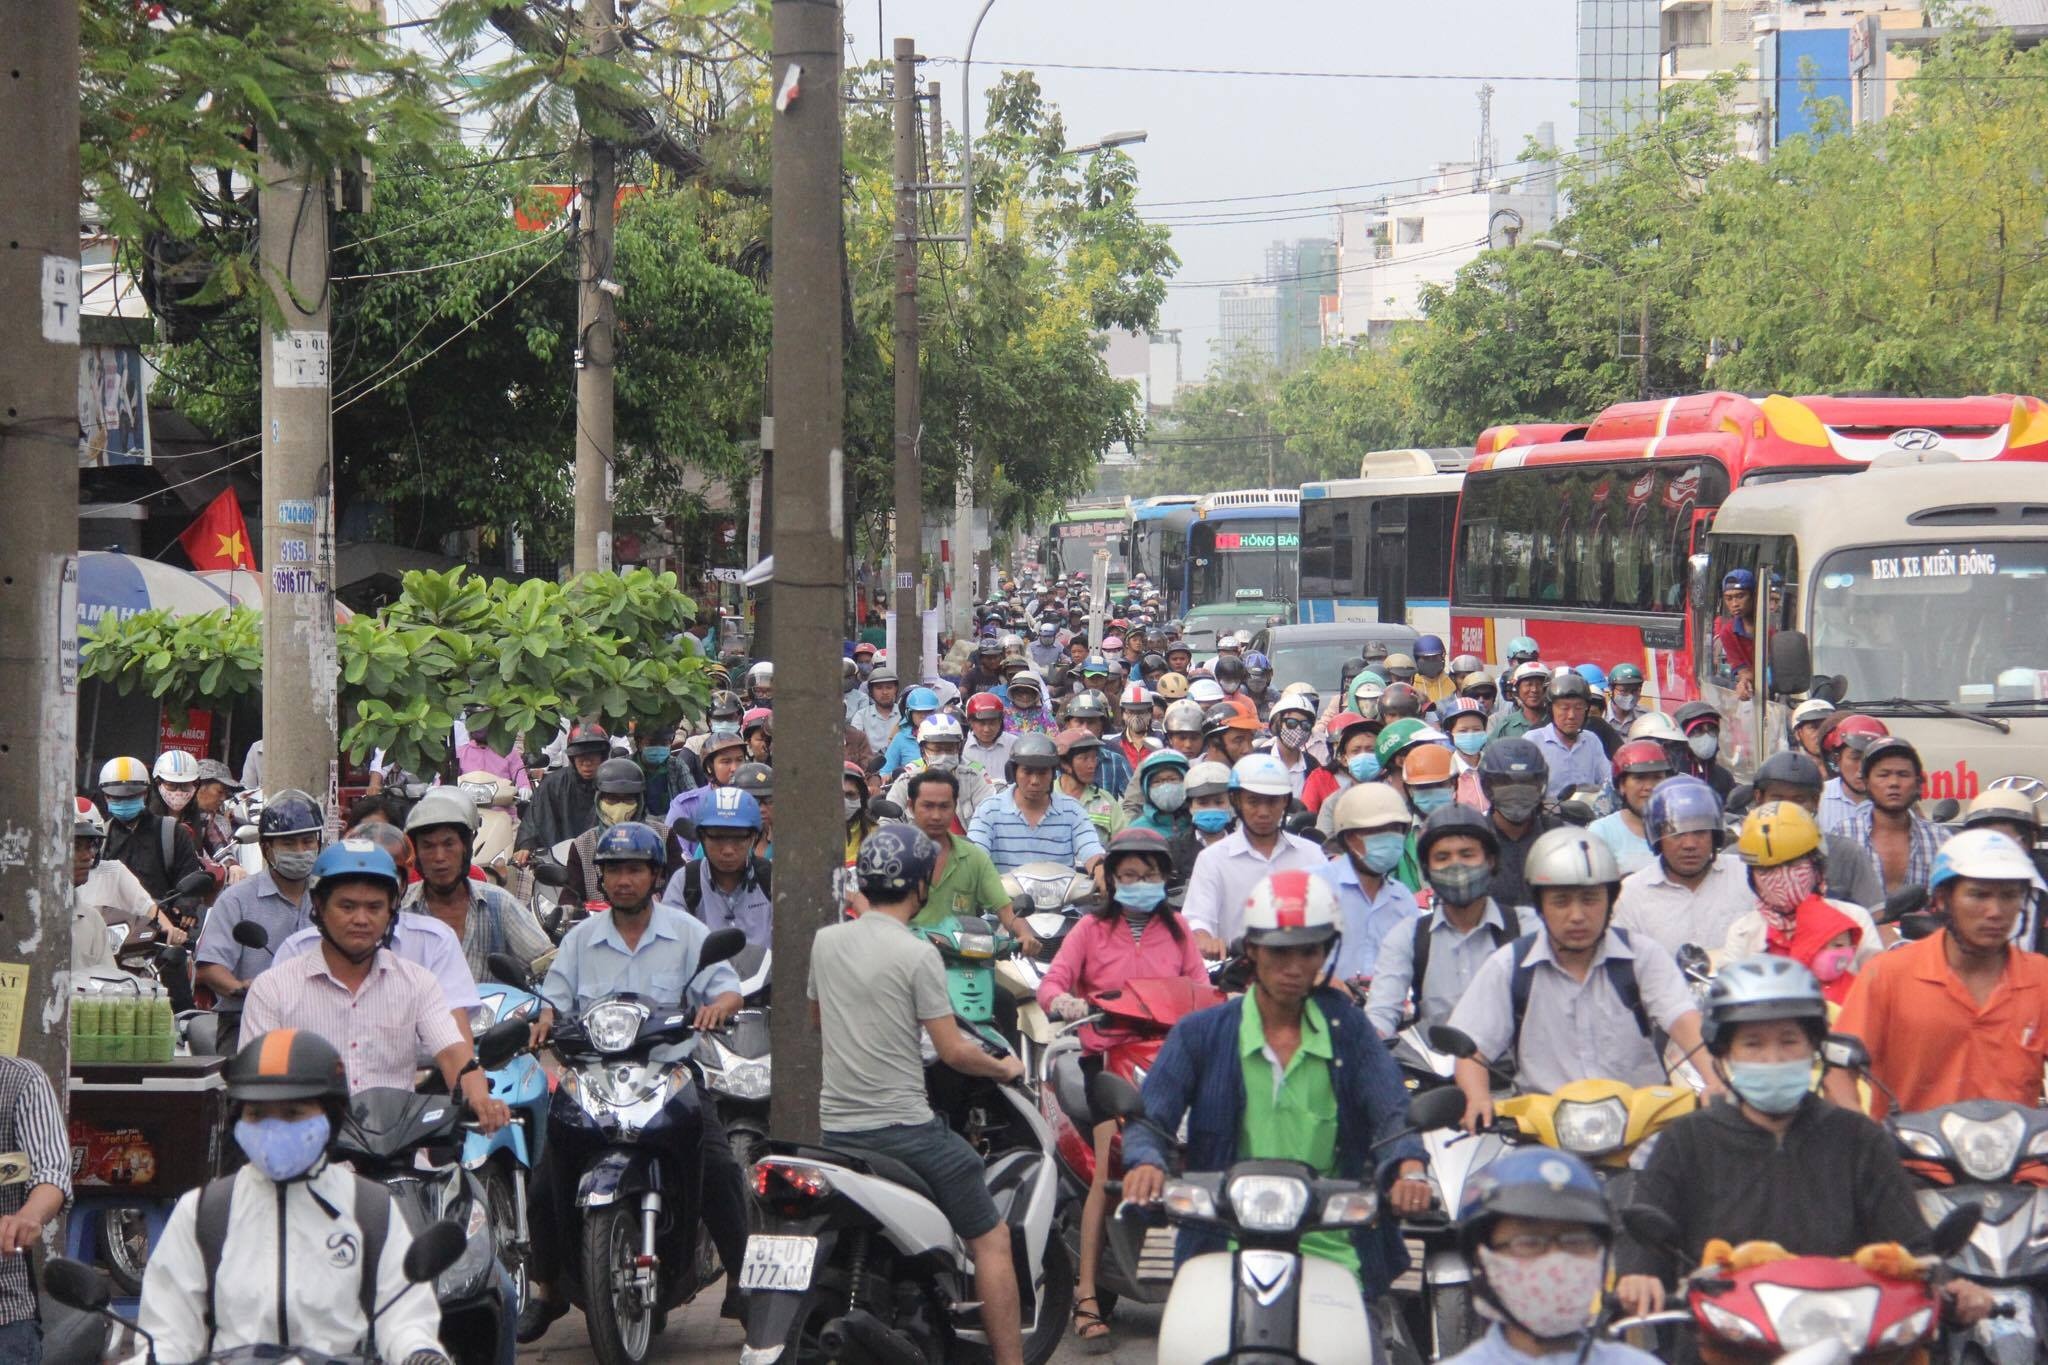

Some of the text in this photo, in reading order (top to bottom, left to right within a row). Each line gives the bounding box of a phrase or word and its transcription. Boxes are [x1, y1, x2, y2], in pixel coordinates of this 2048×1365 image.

[1902, 557, 1920, 578] XE
[1958, 548, 1996, 575] ĐÔNG
[1379, 733, 1400, 754] Grab
